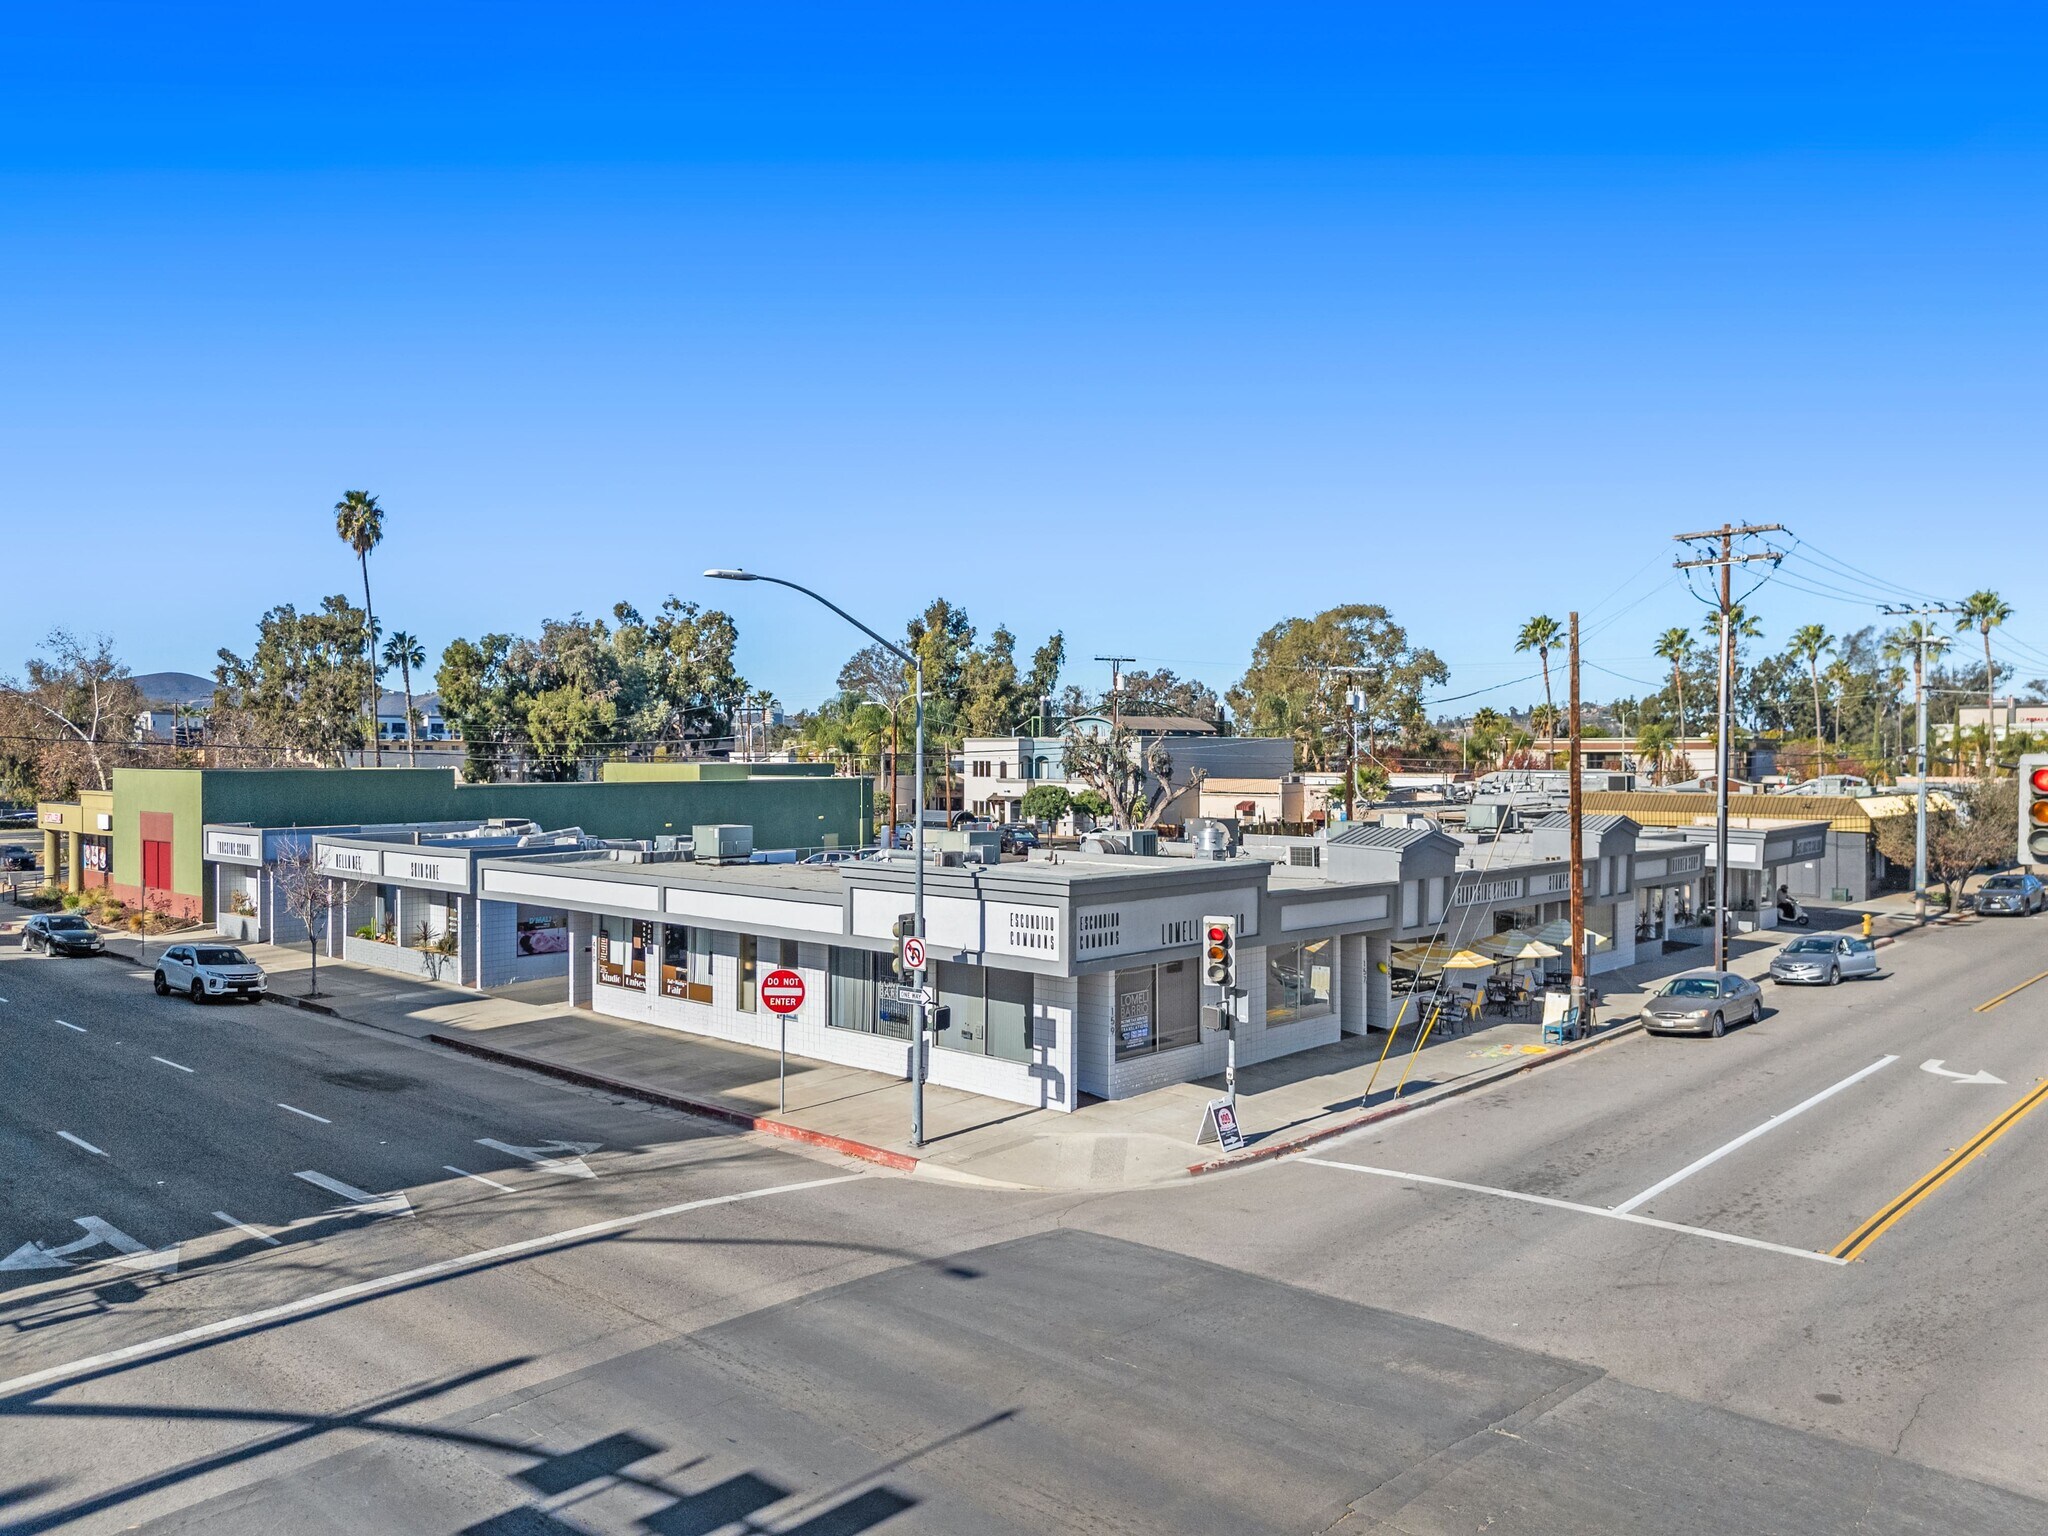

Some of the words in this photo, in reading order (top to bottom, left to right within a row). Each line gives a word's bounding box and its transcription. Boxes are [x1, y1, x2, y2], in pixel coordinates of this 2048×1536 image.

[1010, 912, 1054, 931] ESCONDIDO
[1080, 912, 1119, 931] ESCONDIDO
[1010, 931, 1054, 950] COMMONS
[1080, 930, 1119, 950] COMMONS
[1161, 919, 1199, 945] LOMELI
[767, 977, 780, 986] DO
[783, 977, 800, 986] NOT
[770, 997, 796, 1006] ENTER
[912, 991, 921, 999] WAY
[1120, 992, 1149, 1007] LOMELI
[1121, 1003, 1149, 1018] BARRIO
